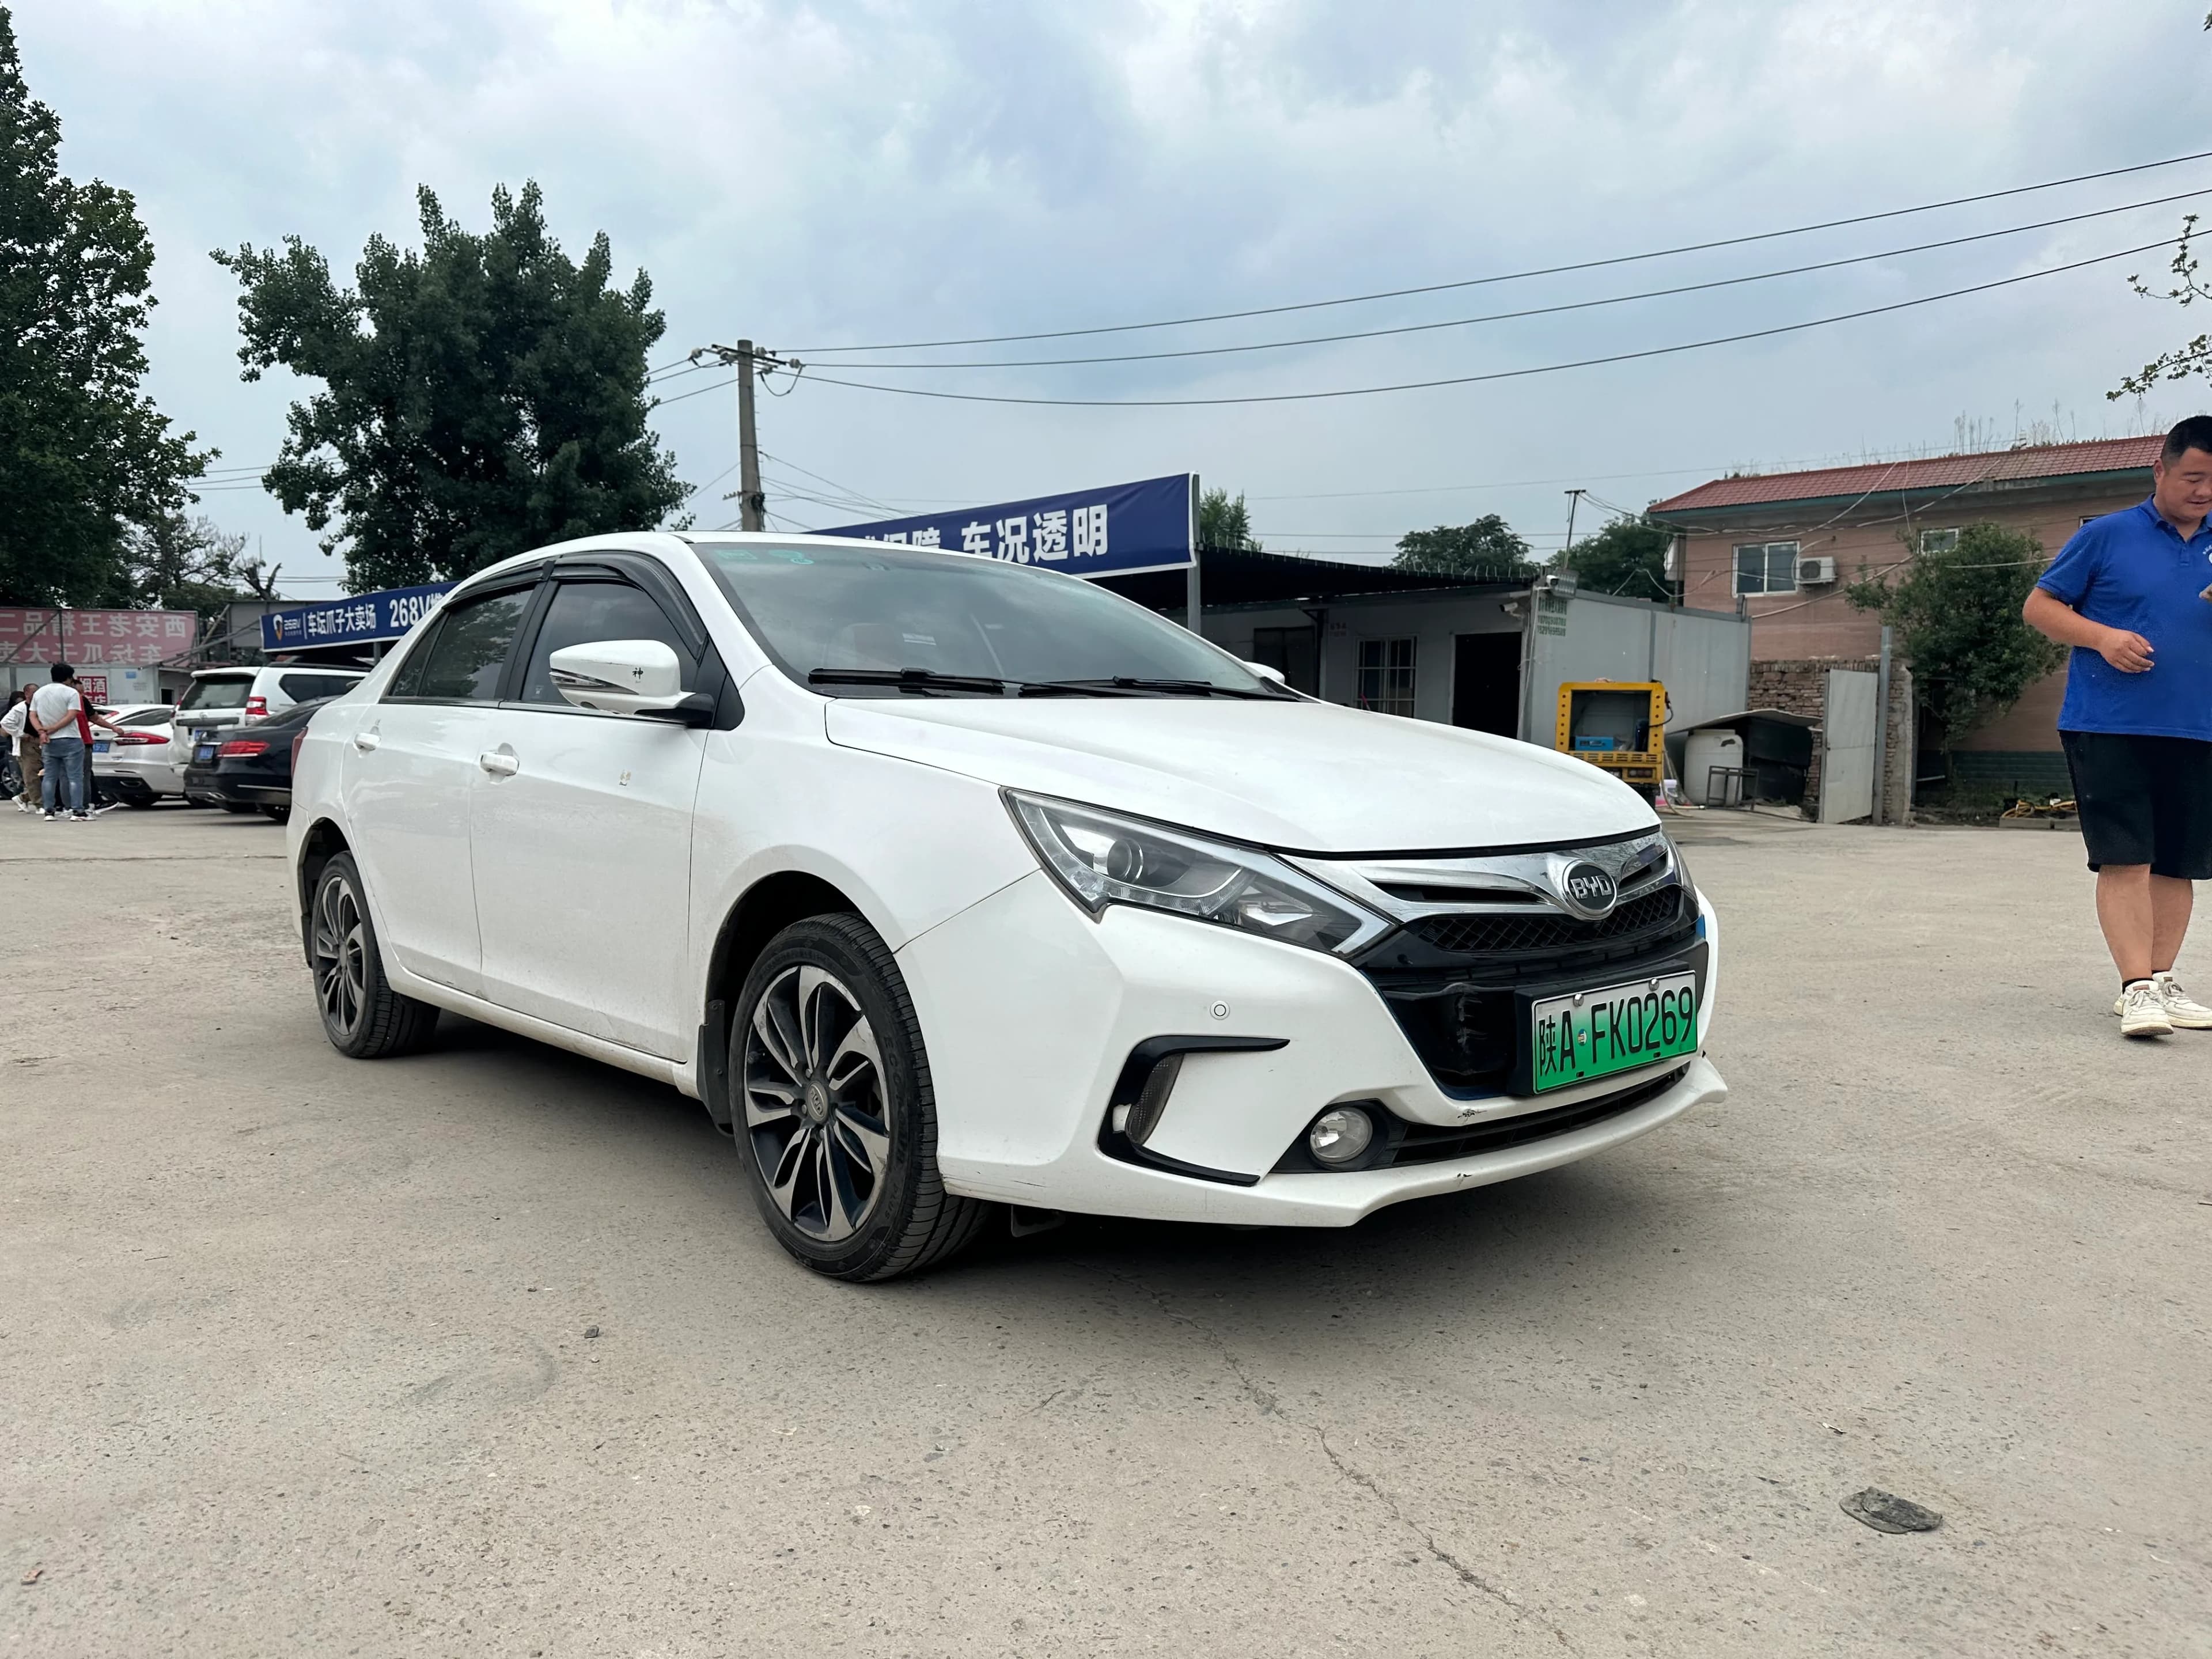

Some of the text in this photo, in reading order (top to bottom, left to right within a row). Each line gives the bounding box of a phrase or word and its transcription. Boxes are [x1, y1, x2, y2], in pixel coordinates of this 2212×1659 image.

[961, 503, 1108, 564] 车况透明
[308, 603, 376, 637] 车坛爪子大卖场
[1570, 875, 1612, 899] BYD
